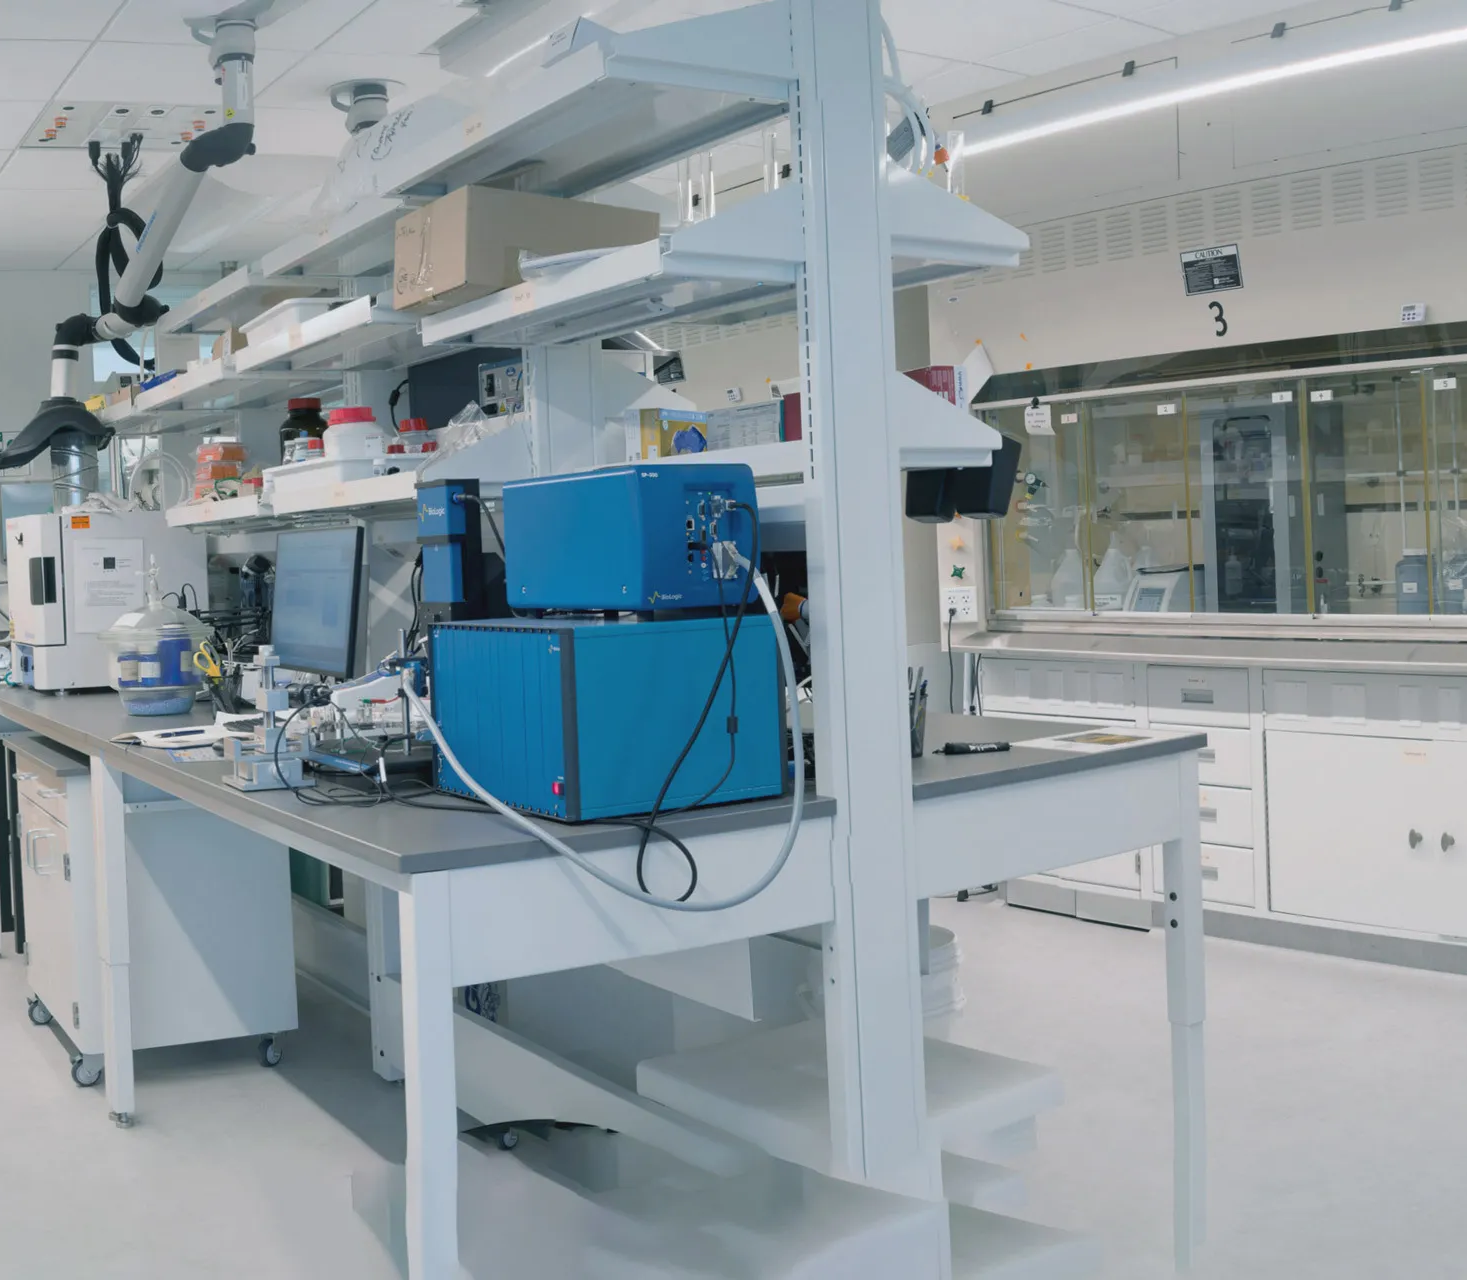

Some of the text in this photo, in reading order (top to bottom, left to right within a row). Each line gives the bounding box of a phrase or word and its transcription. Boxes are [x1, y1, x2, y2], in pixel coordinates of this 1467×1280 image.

[1195, 248, 1224, 260] CAUTION
[1208, 301, 1228, 337] 3
[661, 592, 682, 602] BioLogic
